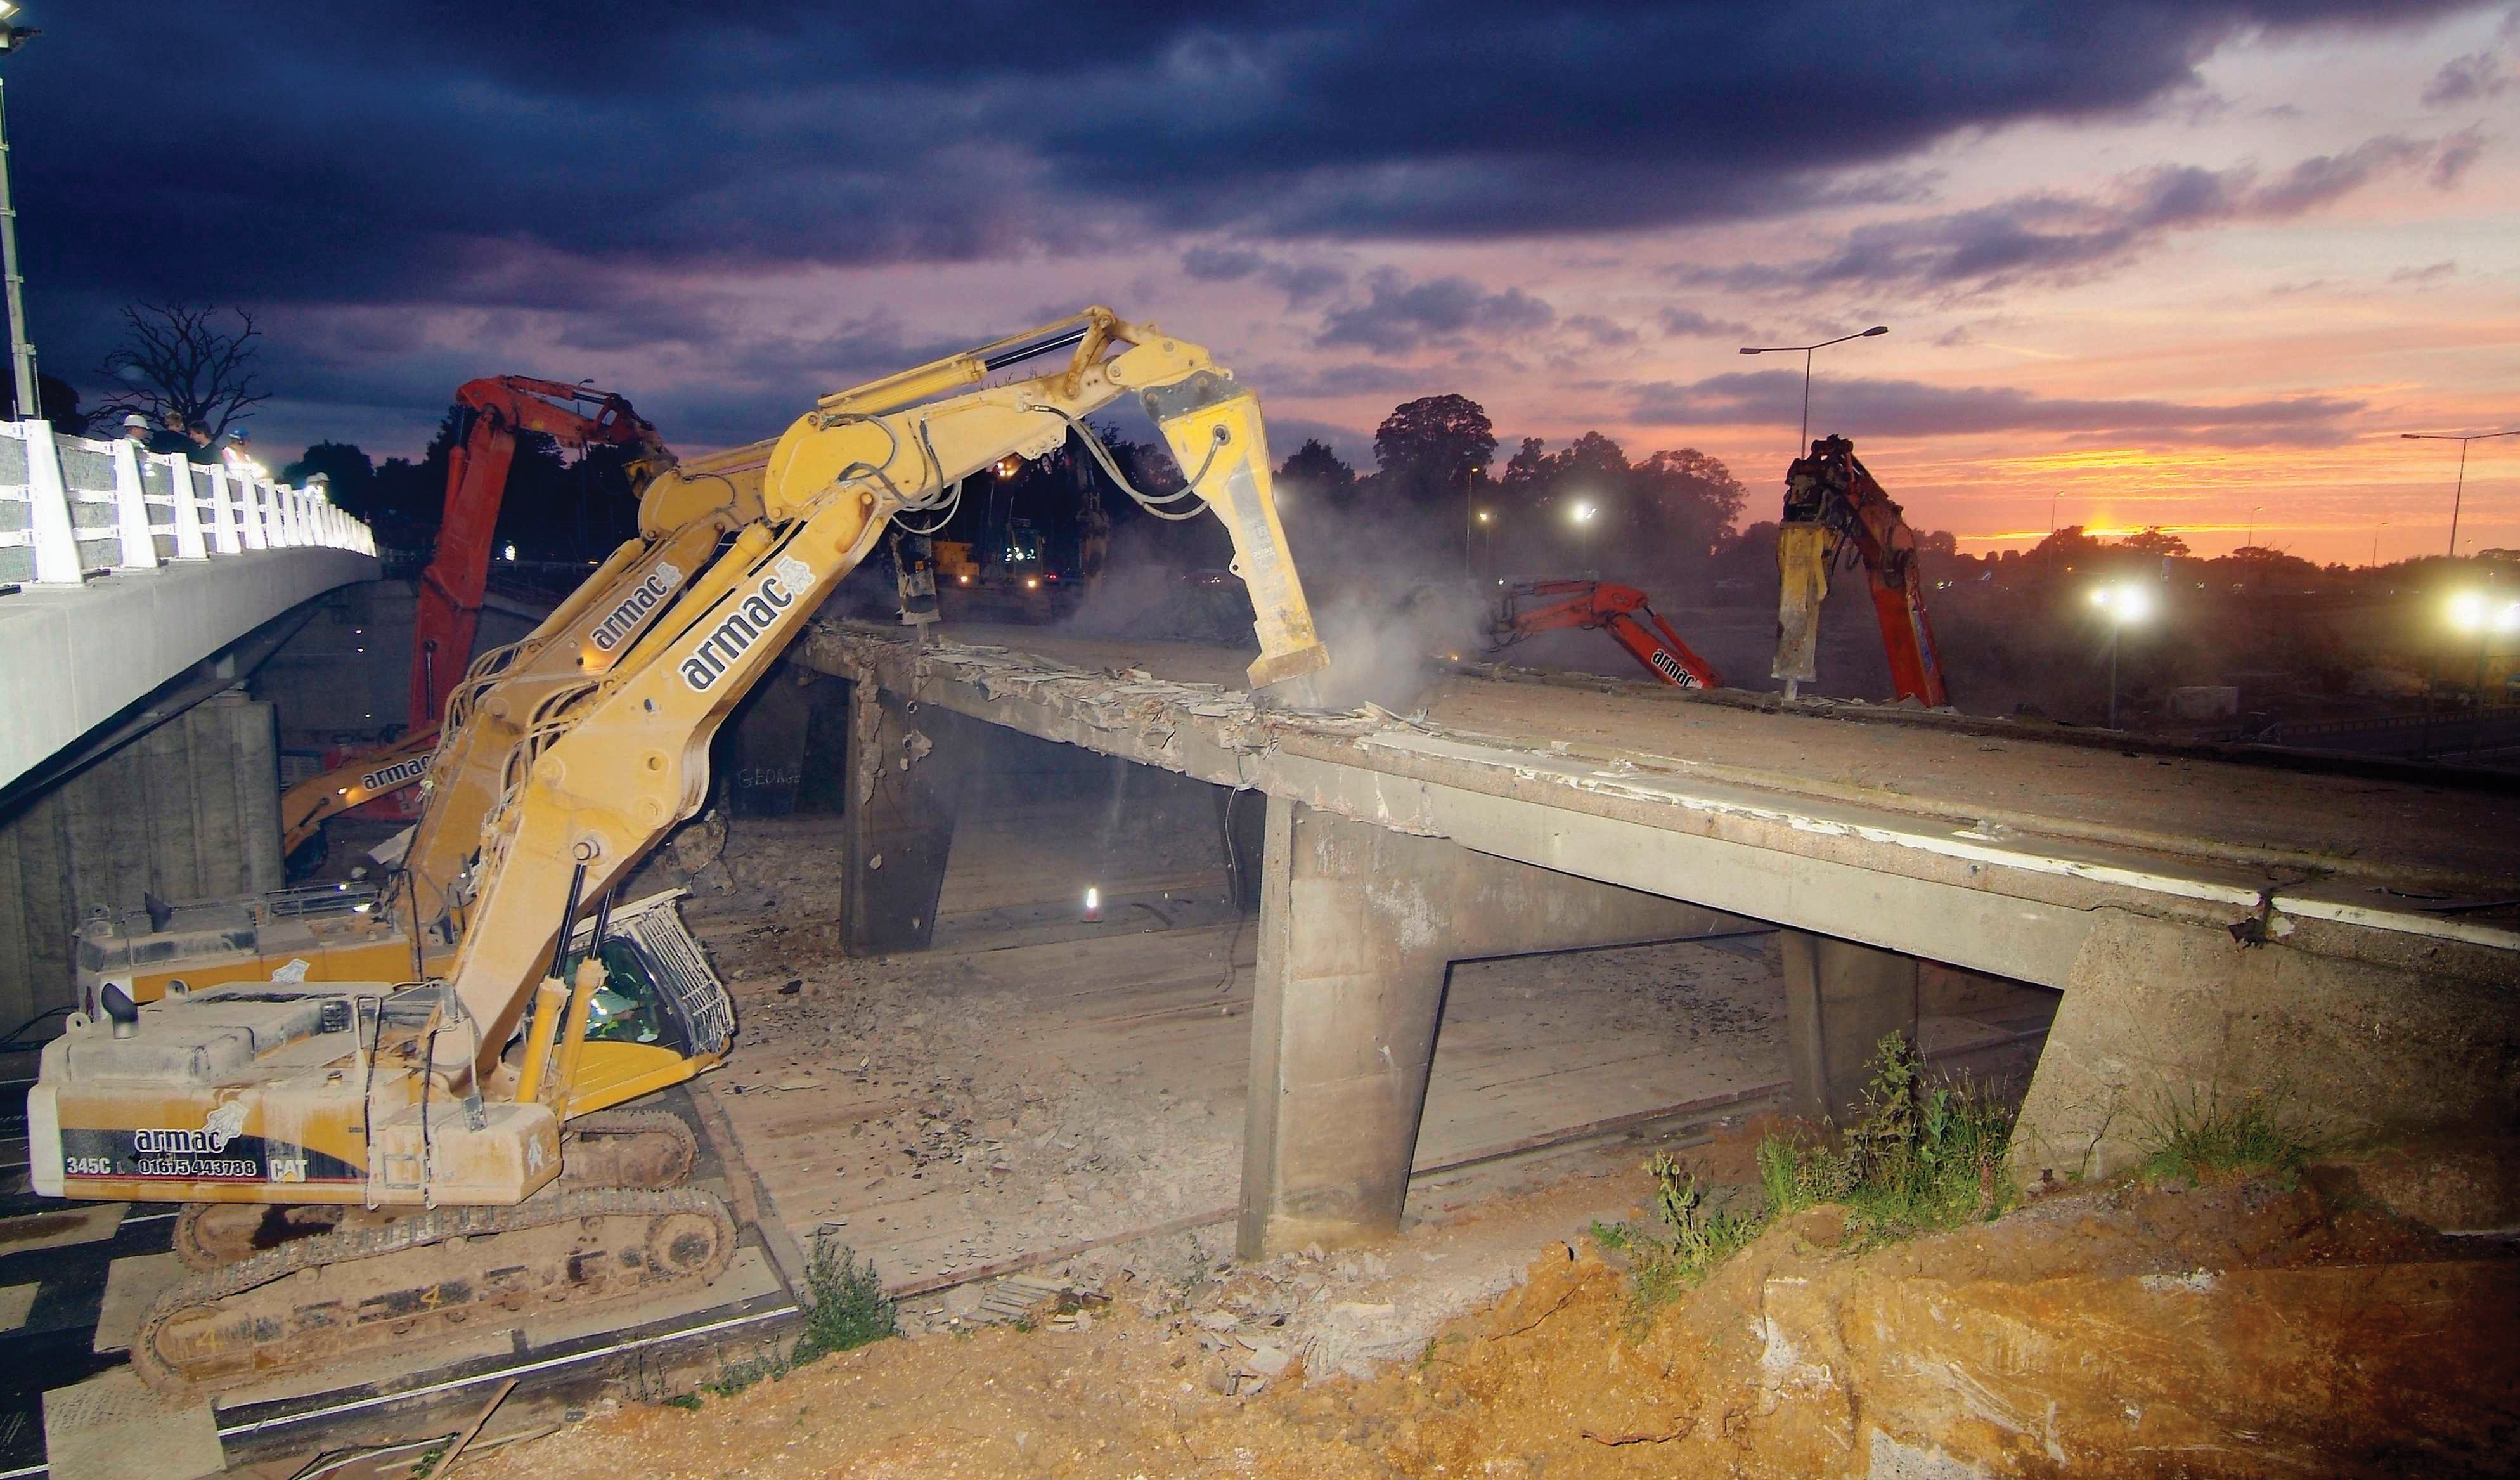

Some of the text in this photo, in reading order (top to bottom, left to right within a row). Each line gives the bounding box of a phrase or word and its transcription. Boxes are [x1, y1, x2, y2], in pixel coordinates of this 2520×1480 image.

[591, 574, 668, 650] armac
[681, 578, 792, 691] armac
[137, 1129, 222, 1152] armac
[67, 1157, 111, 1174] 345C
[139, 1159, 257, 1176] 01675 443788
[271, 1159, 307, 1182] CAT
